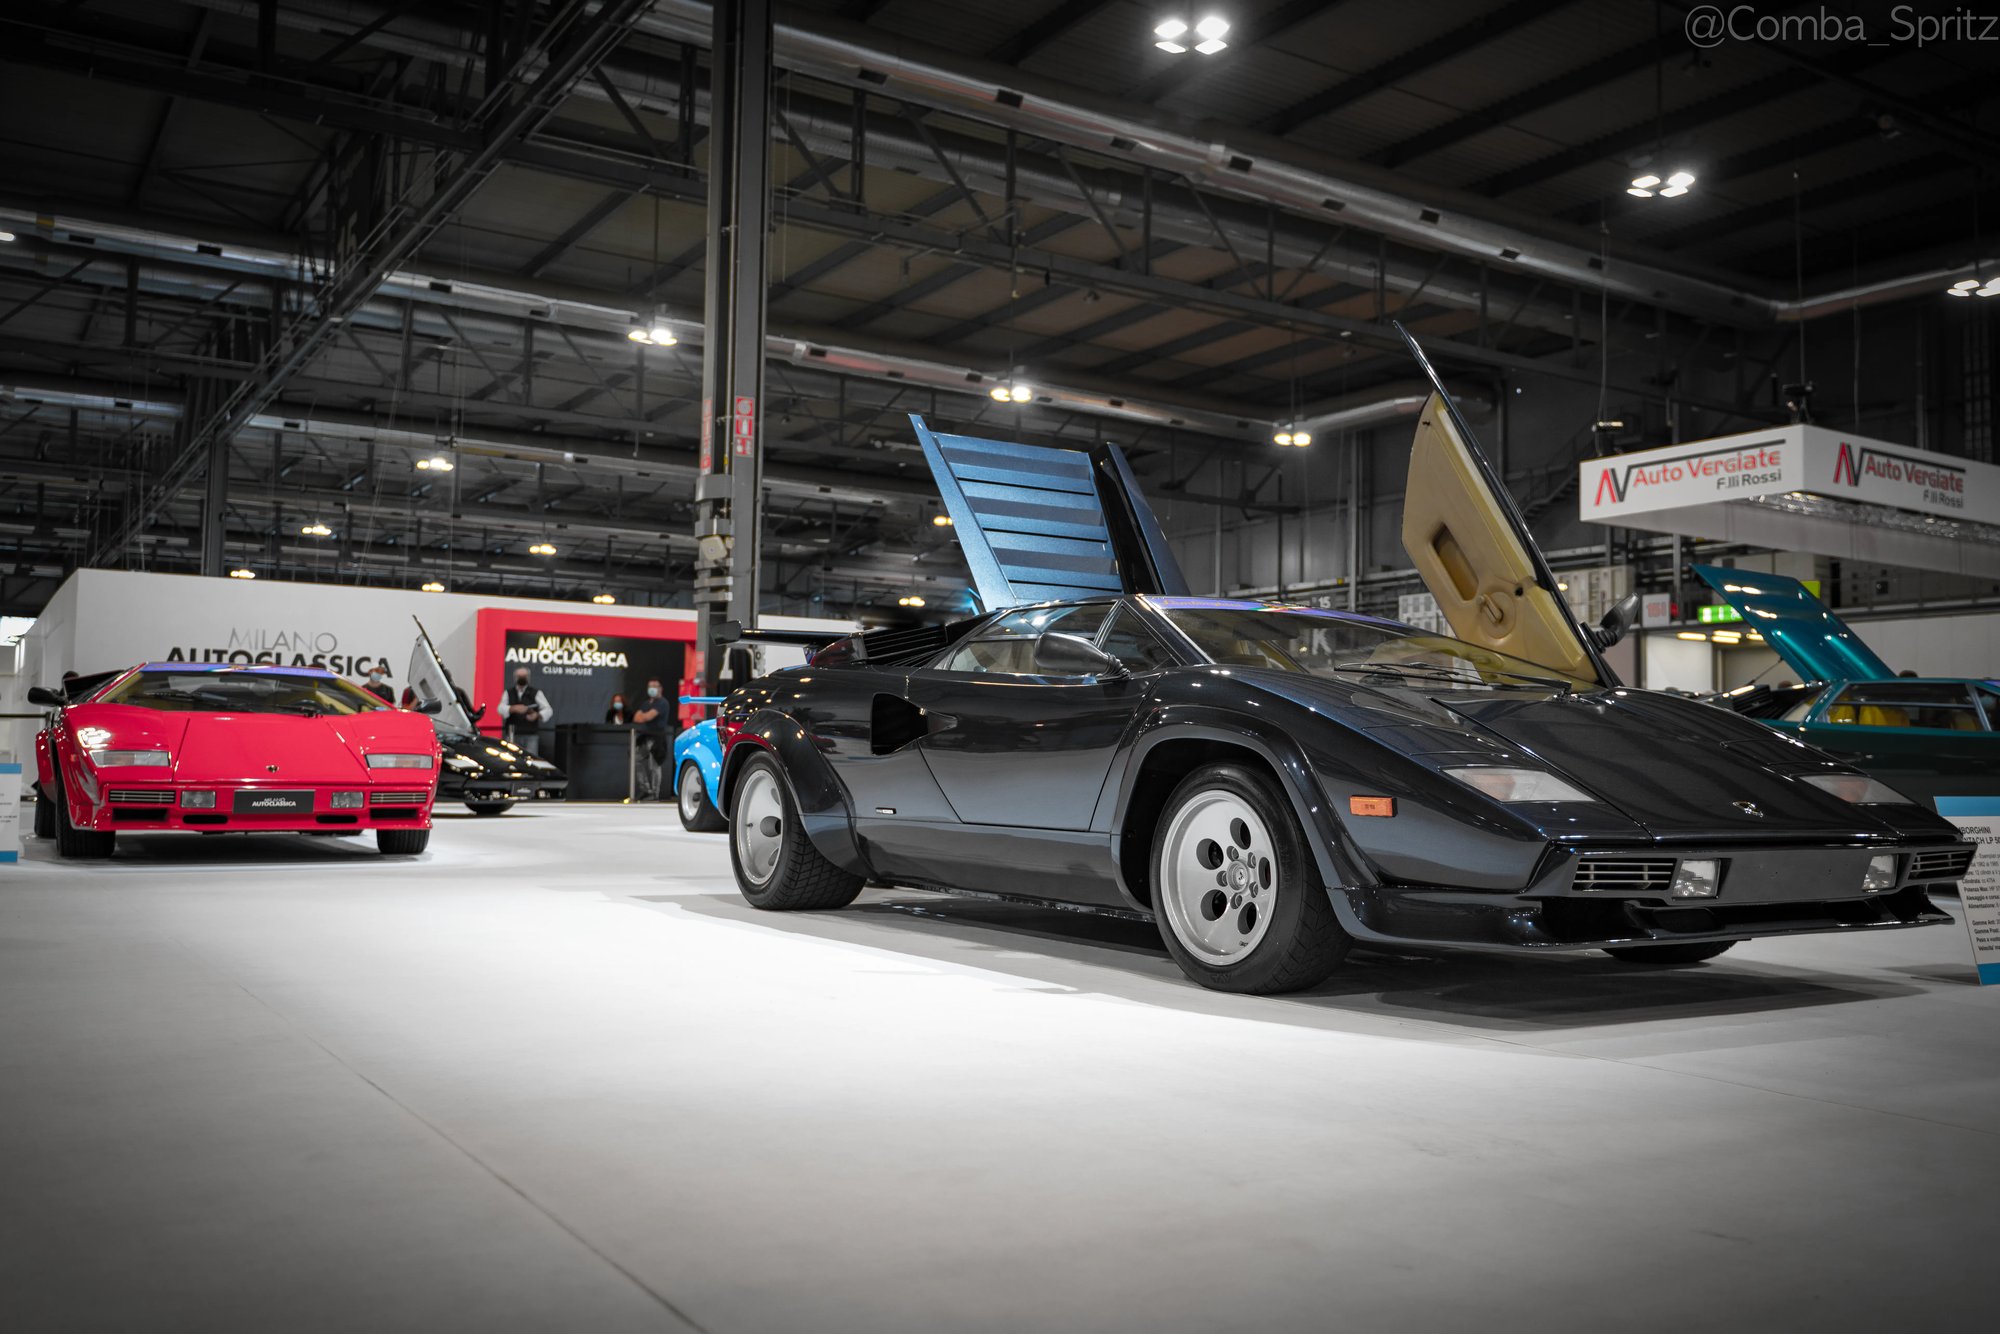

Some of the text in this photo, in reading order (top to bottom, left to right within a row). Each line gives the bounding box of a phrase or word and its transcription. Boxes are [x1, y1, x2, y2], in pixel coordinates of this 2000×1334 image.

[1633, 465, 1683, 488] Auto
[1686, 448, 1781, 479] Vergiate
[1865, 454, 1902, 480] Auto
[1903, 461, 1964, 494] Vergiate
[1741, 469, 1782, 487] Rossi
[1938, 491, 1964, 509] Rossi
[228, 627, 338, 653] MILANO
[538, 635, 599, 652] MILANO
[505, 647, 629, 668] AUTOCLASSICA
[542, 665, 593, 676] CLUB HOUSE
[1959, 826, 1991, 834] BORGHINI
